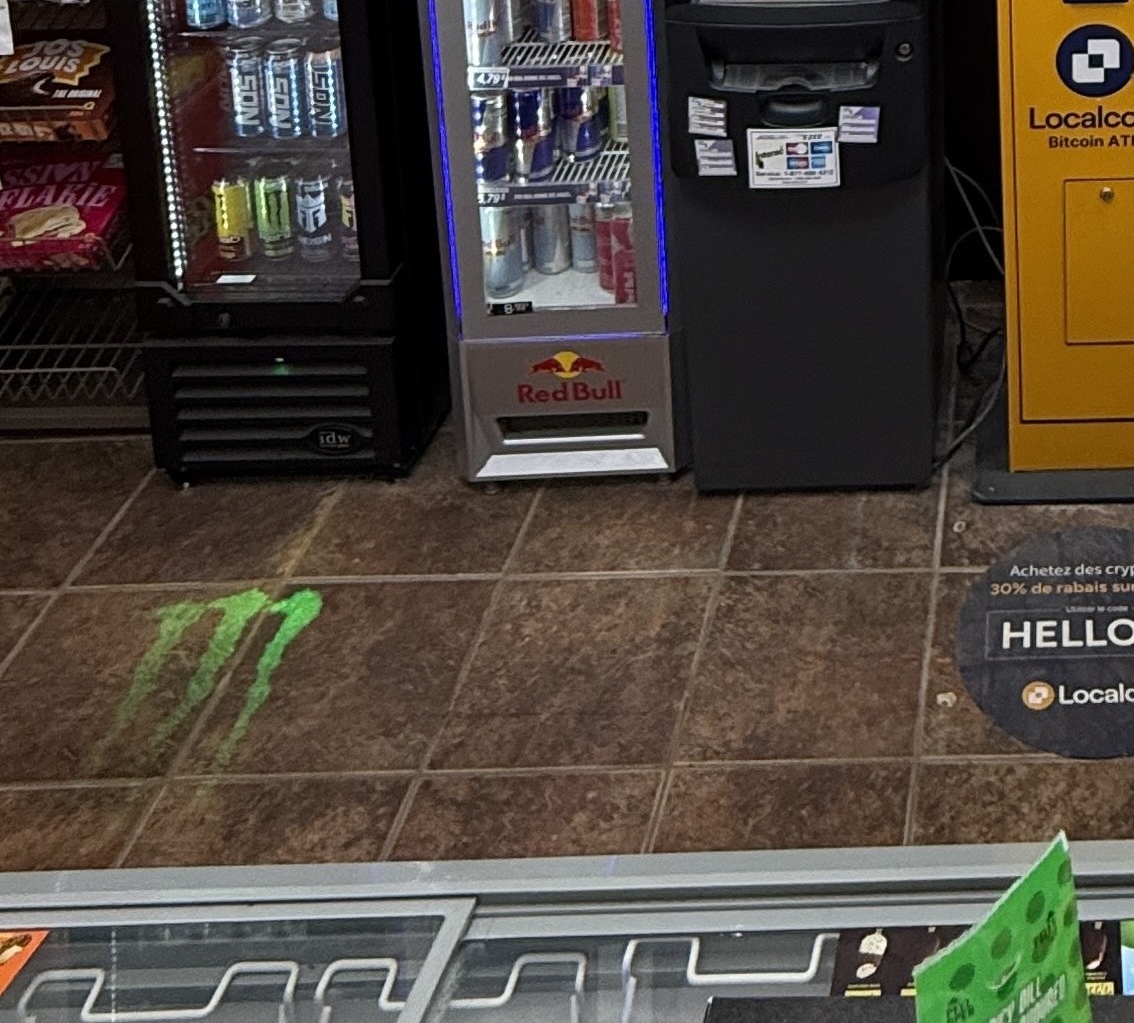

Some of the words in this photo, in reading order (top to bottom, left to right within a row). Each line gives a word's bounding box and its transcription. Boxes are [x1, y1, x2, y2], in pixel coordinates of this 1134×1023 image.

[4, 56, 81, 74] LOUIS
[1048, 134, 1104, 148] Bitcoin
[516, 382, 570, 404] Red
[573, 380, 623, 402] Bull
[1009, 564, 1071, 577] Achetez
[1074, 562, 1102, 576] des
[990, 582, 1027, 596] 30%
[1031, 582, 1052, 595] de
[1056, 581, 1108, 594] rabais
